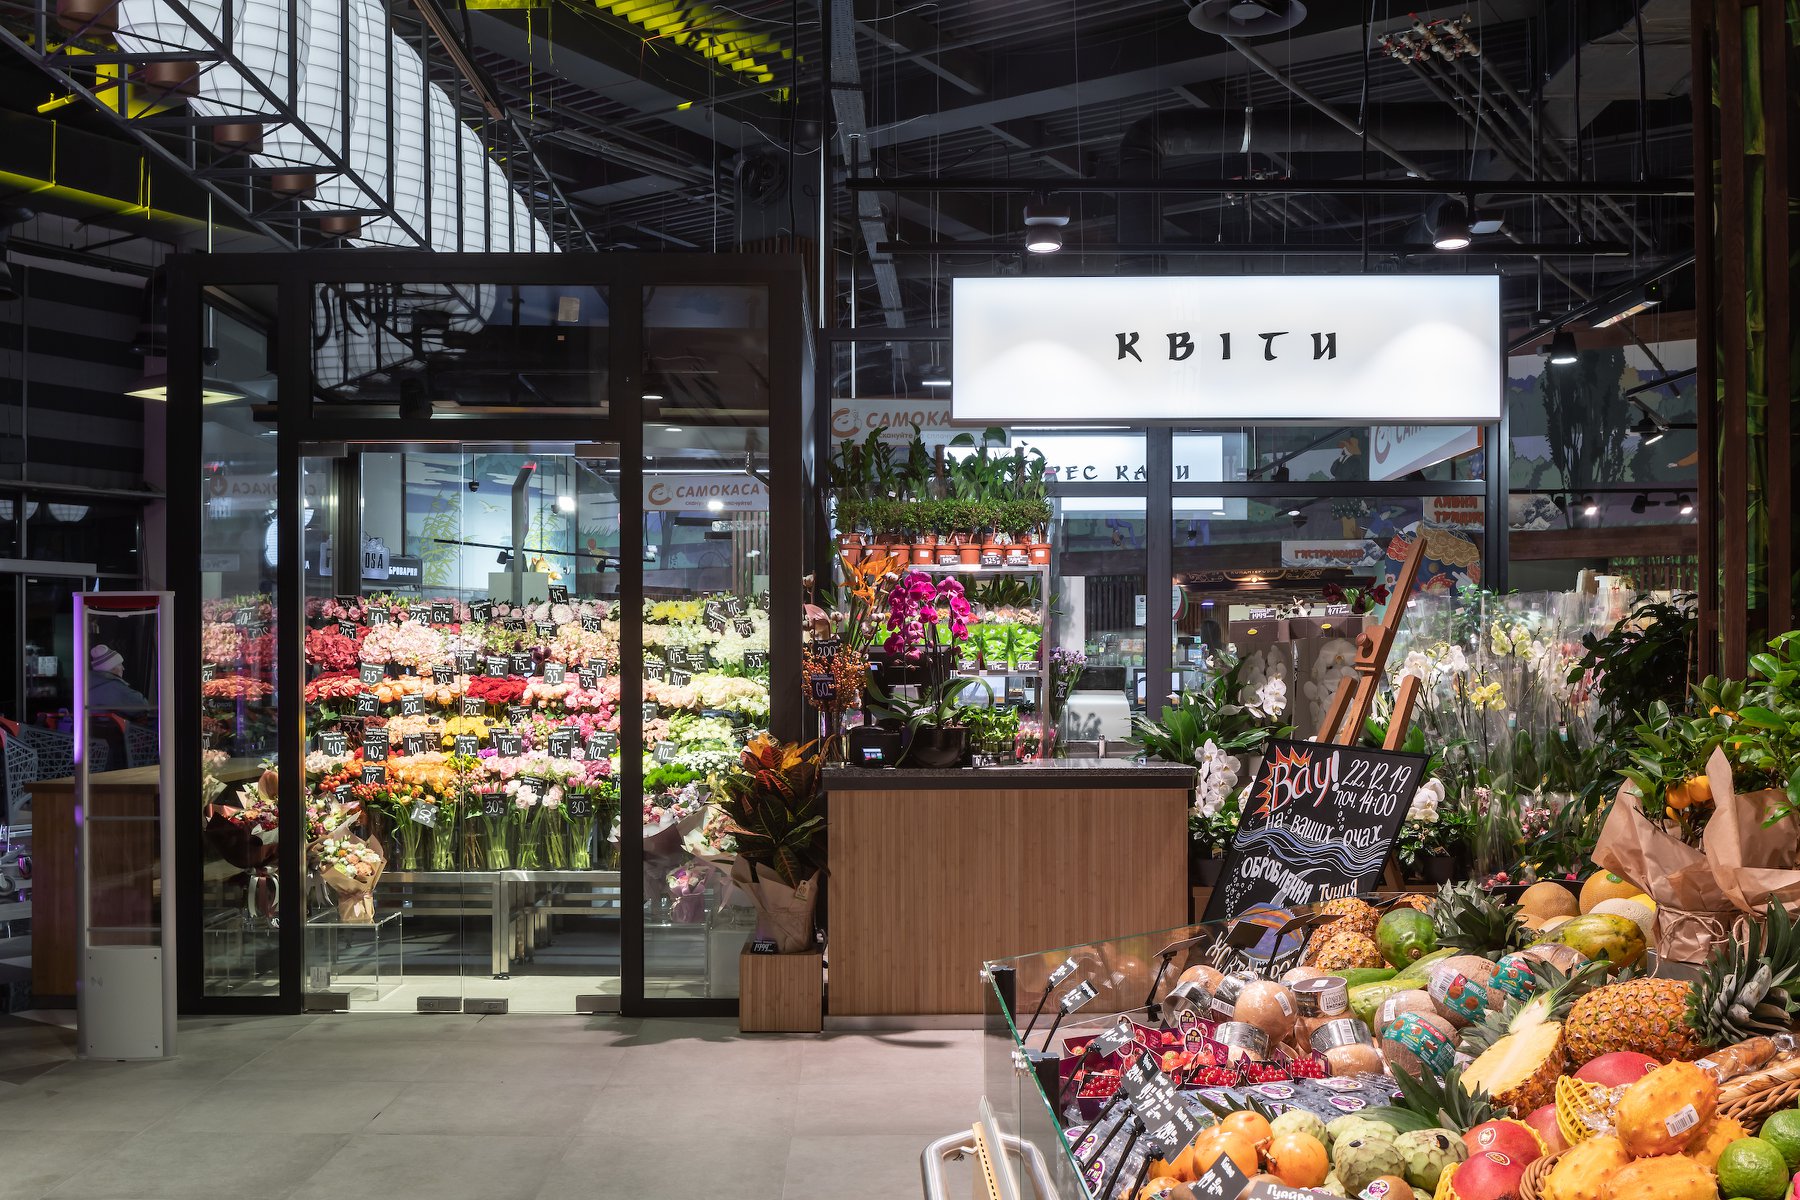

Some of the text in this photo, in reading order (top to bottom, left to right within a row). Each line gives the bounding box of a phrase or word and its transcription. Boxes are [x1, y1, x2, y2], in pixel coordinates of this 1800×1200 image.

[1115, 331, 1337, 362] КВІТИ
[1116, 465, 1189, 481] КАИ
[676, 483, 759, 498] САМОКАСА
[371, 612, 384, 625] 40
[434, 611, 446, 622] 64
[512, 659, 525, 671] 75
[747, 655, 761, 667] 35
[363, 670, 377, 683] 55
[491, 665, 502, 676] 50
[547, 669, 559, 683] 35
[816, 682, 828, 697] 60
[404, 702, 417, 715] 20
[464, 703, 477, 716] 20
[328, 741, 341, 755] 40
[367, 745, 380, 759] 40
[501, 740, 513, 755] 40
[551, 740, 564, 756] 45
[589, 742, 601, 760] 40
[485, 800, 499, 815] 30
[571, 801, 585, 815] 30
[1358, 790, 1397, 817] 14:00
[1265, 811, 1383, 848] на ваших очах
